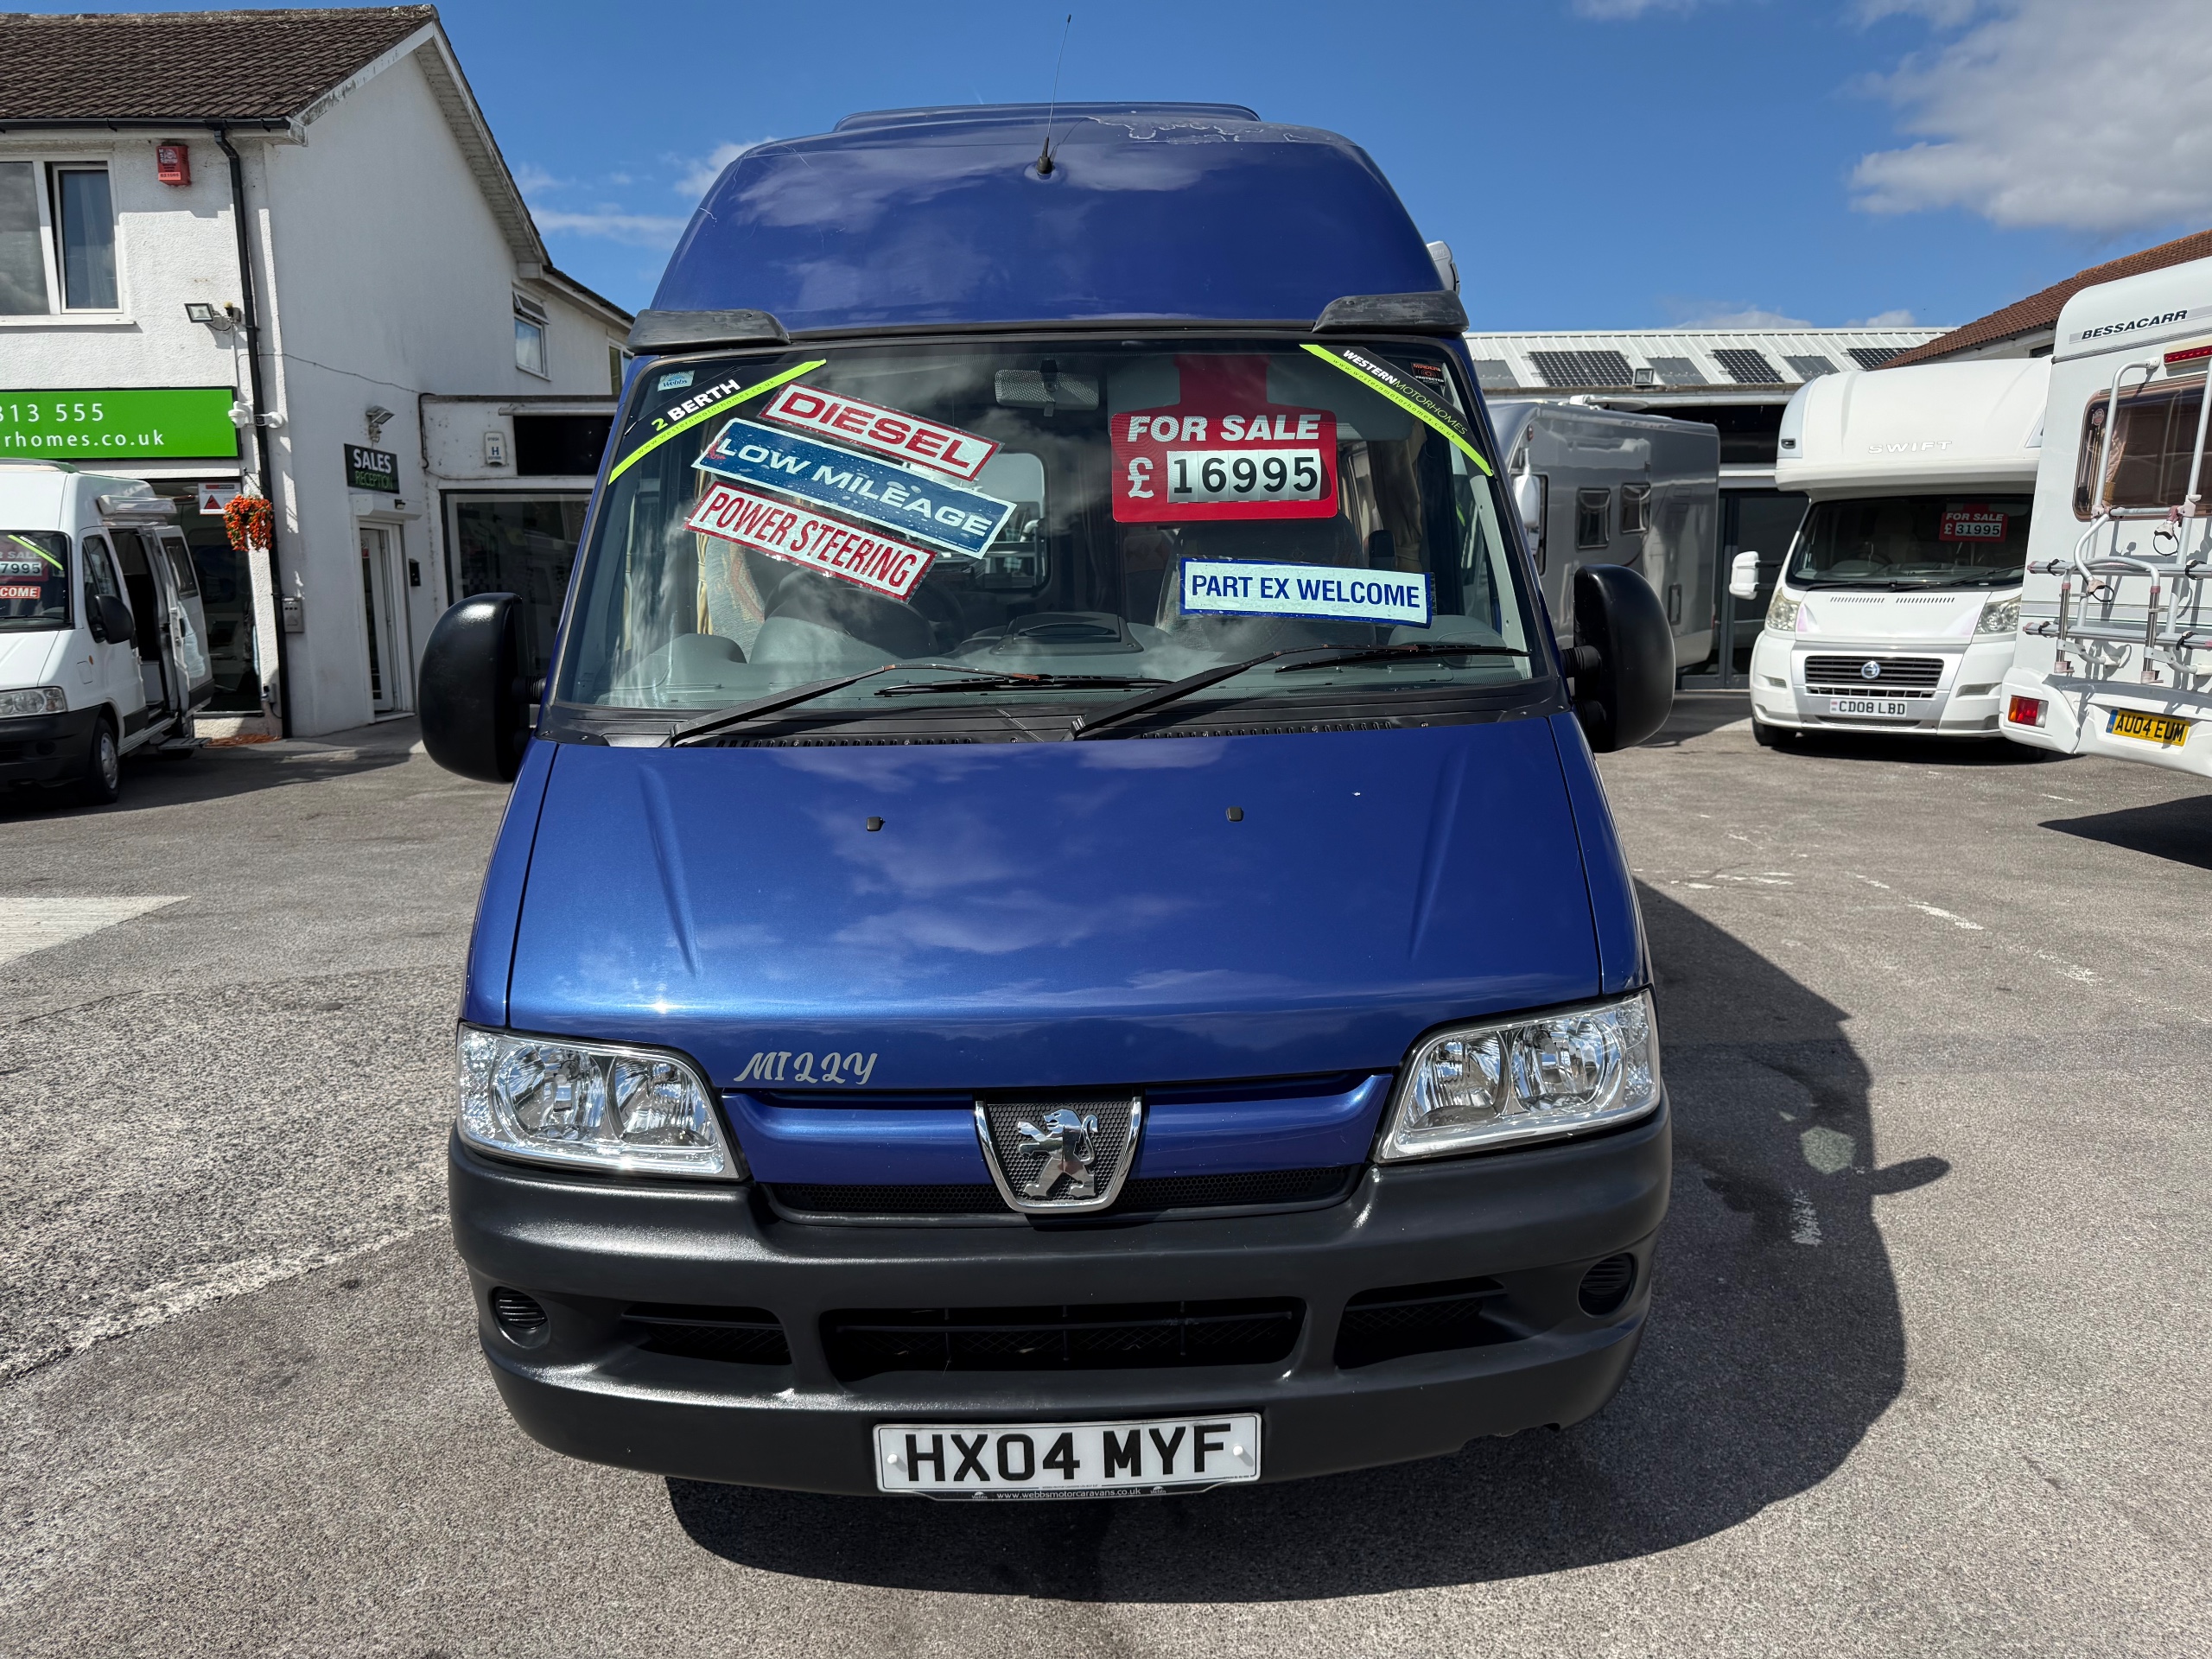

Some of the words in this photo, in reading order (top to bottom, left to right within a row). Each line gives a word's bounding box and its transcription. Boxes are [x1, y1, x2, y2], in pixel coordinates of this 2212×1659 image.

[2082, 309, 2188, 340] BESSACARR
[651, 417, 668, 432] 2
[666, 378, 741, 422] BERTH
[1343, 349, 1468, 435] WESTERNMOTORHOMES
[55, 403, 104, 422] 555
[4, 429, 164, 448] rhomes.co.uk
[779, 391, 973, 471] DIESEL
[1128, 415, 1207, 442] FOR
[1220, 414, 1322, 442] SALE
[492, 446, 499, 456] H
[1868, 441, 1953, 454] SWIFT
[353, 448, 391, 474] SALES
[355, 470, 394, 490] RECEPTION
[716, 438, 811, 476] LOW
[810, 465, 995, 537] MILEAGE
[1128, 457, 1154, 499] £
[1173, 455, 1319, 495] 16995
[1956, 524, 2000, 536] 31995
[1973, 513, 2005, 522] SALE
[701, 493, 794, 550] POWER
[791, 520, 918, 588] STEERING
[1192, 575, 1253, 598] PART
[1261, 579, 1288, 600] EX
[1298, 580, 1421, 608] WELCOME
[1878, 702, 1905, 715] LBD
[2154, 720, 2186, 741] EUM
[906, 1432, 1081, 1482] HX04
[1103, 1423, 1231, 1478] MYF
[996, 1487, 1141, 1499] www.webbsmotorcaravans.co.uk
